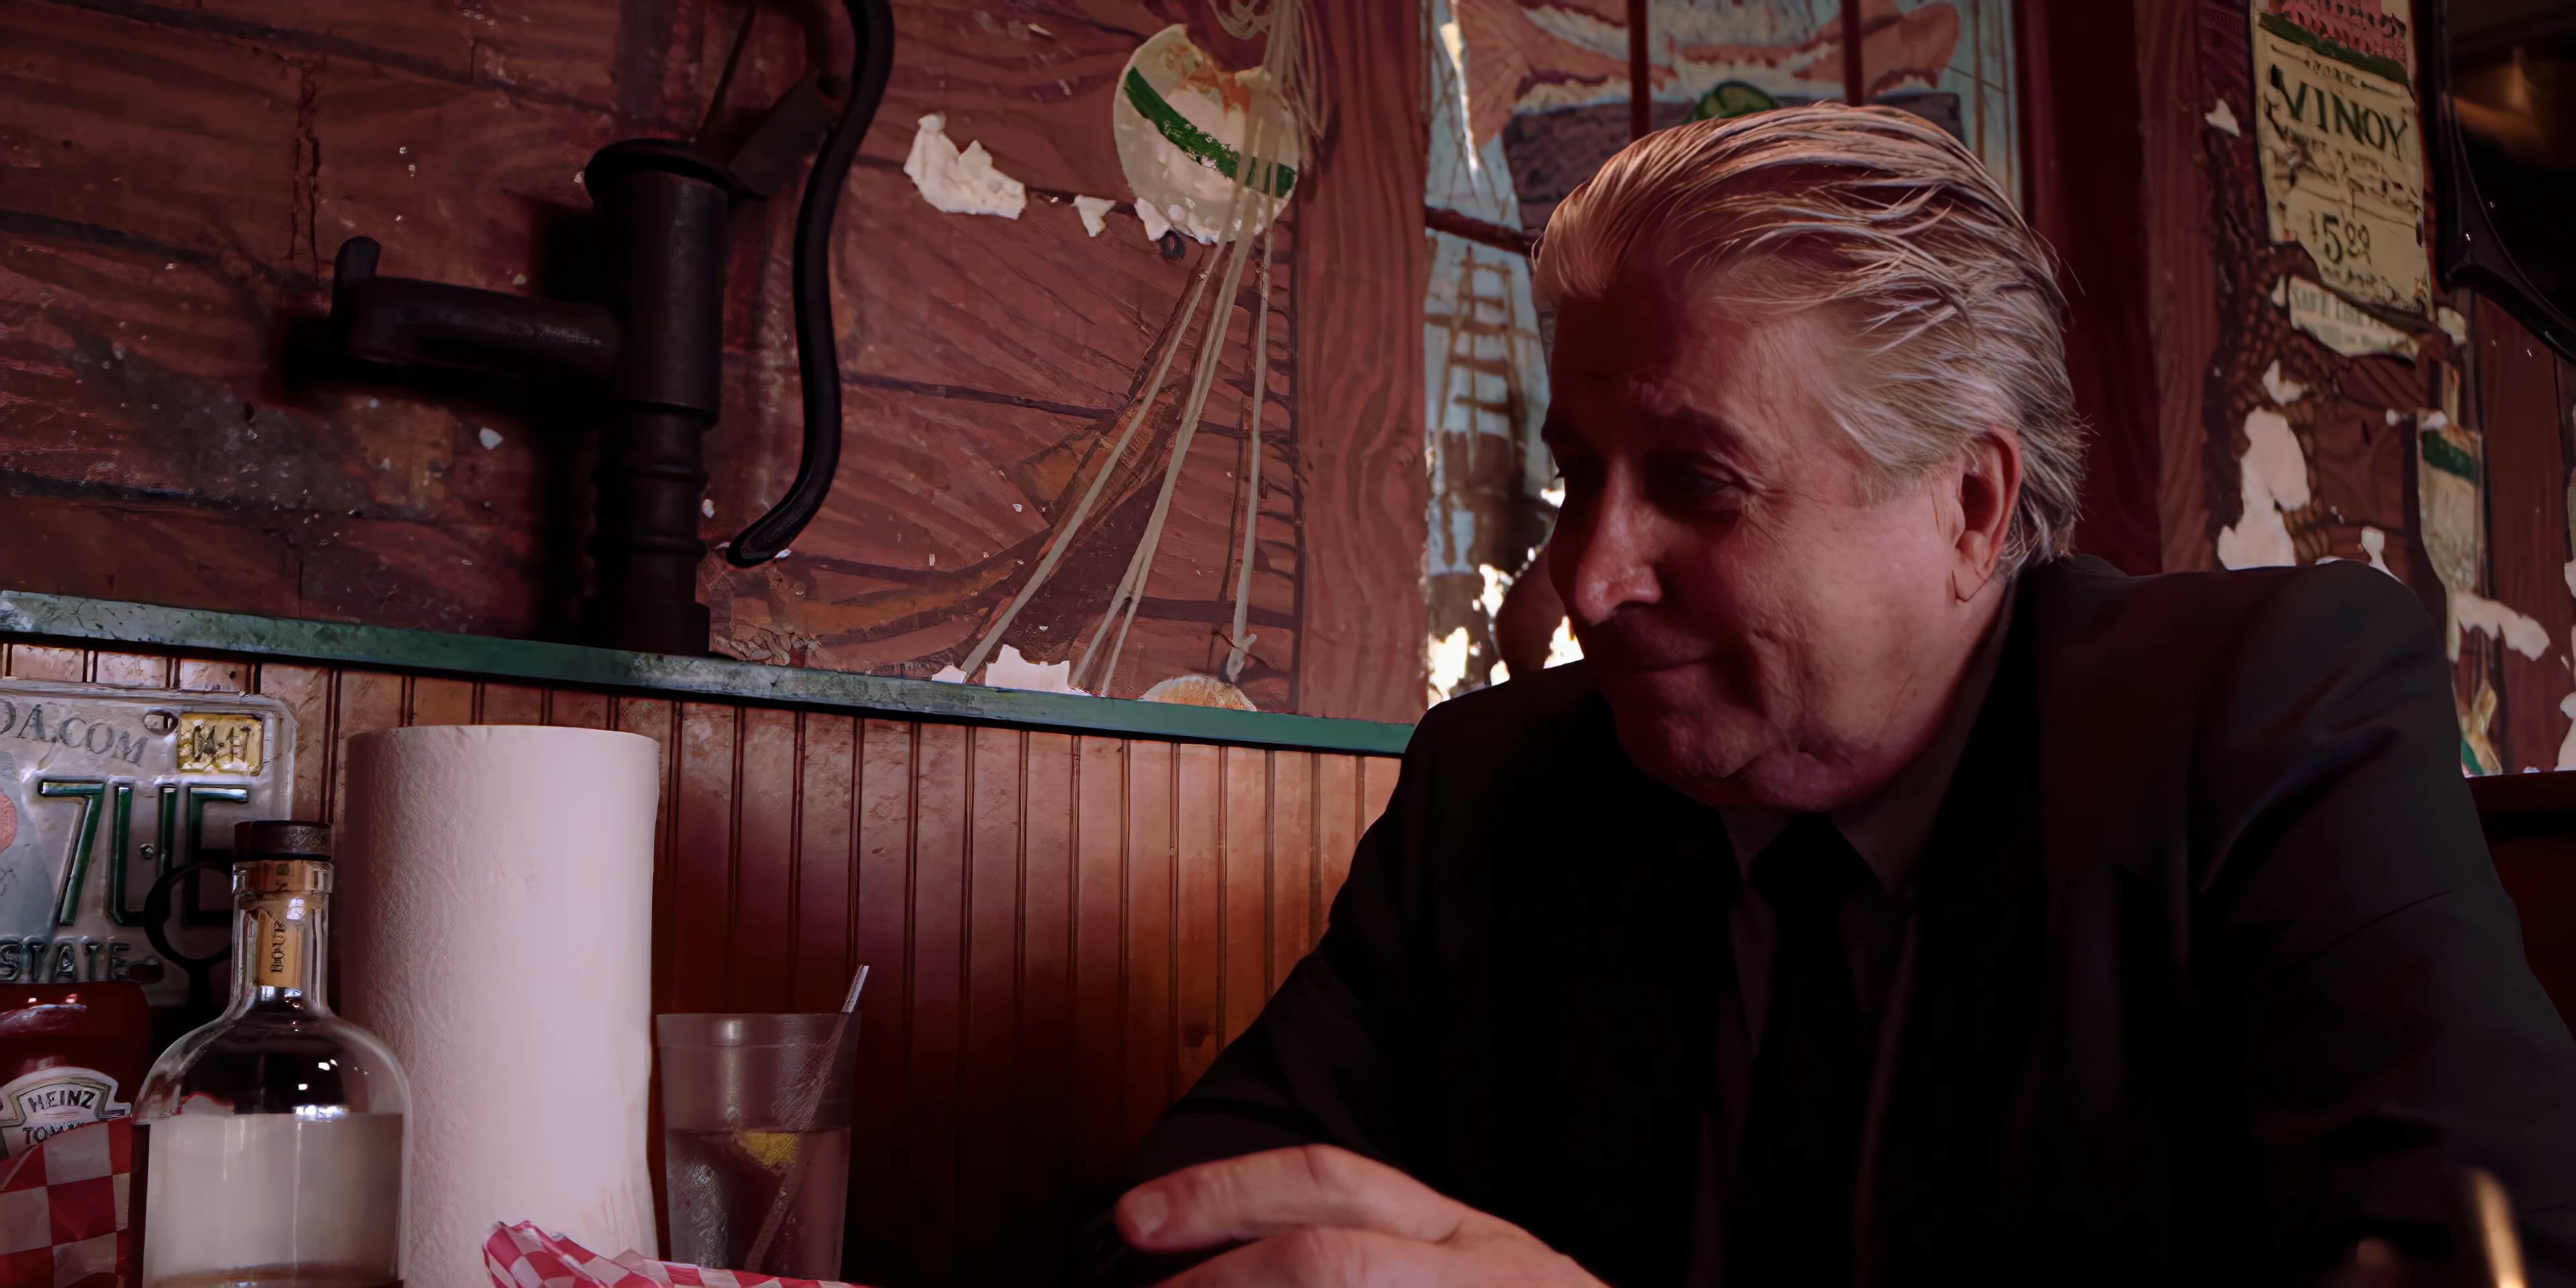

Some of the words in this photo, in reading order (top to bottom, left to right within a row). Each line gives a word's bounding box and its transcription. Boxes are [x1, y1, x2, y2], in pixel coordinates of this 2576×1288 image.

[2271, 64, 2408, 164] VINOY
[38, 780, 249, 925] 7UE
[0, 941, 130, 982] STATE
[28, 1089, 96, 1113] HEINZ
